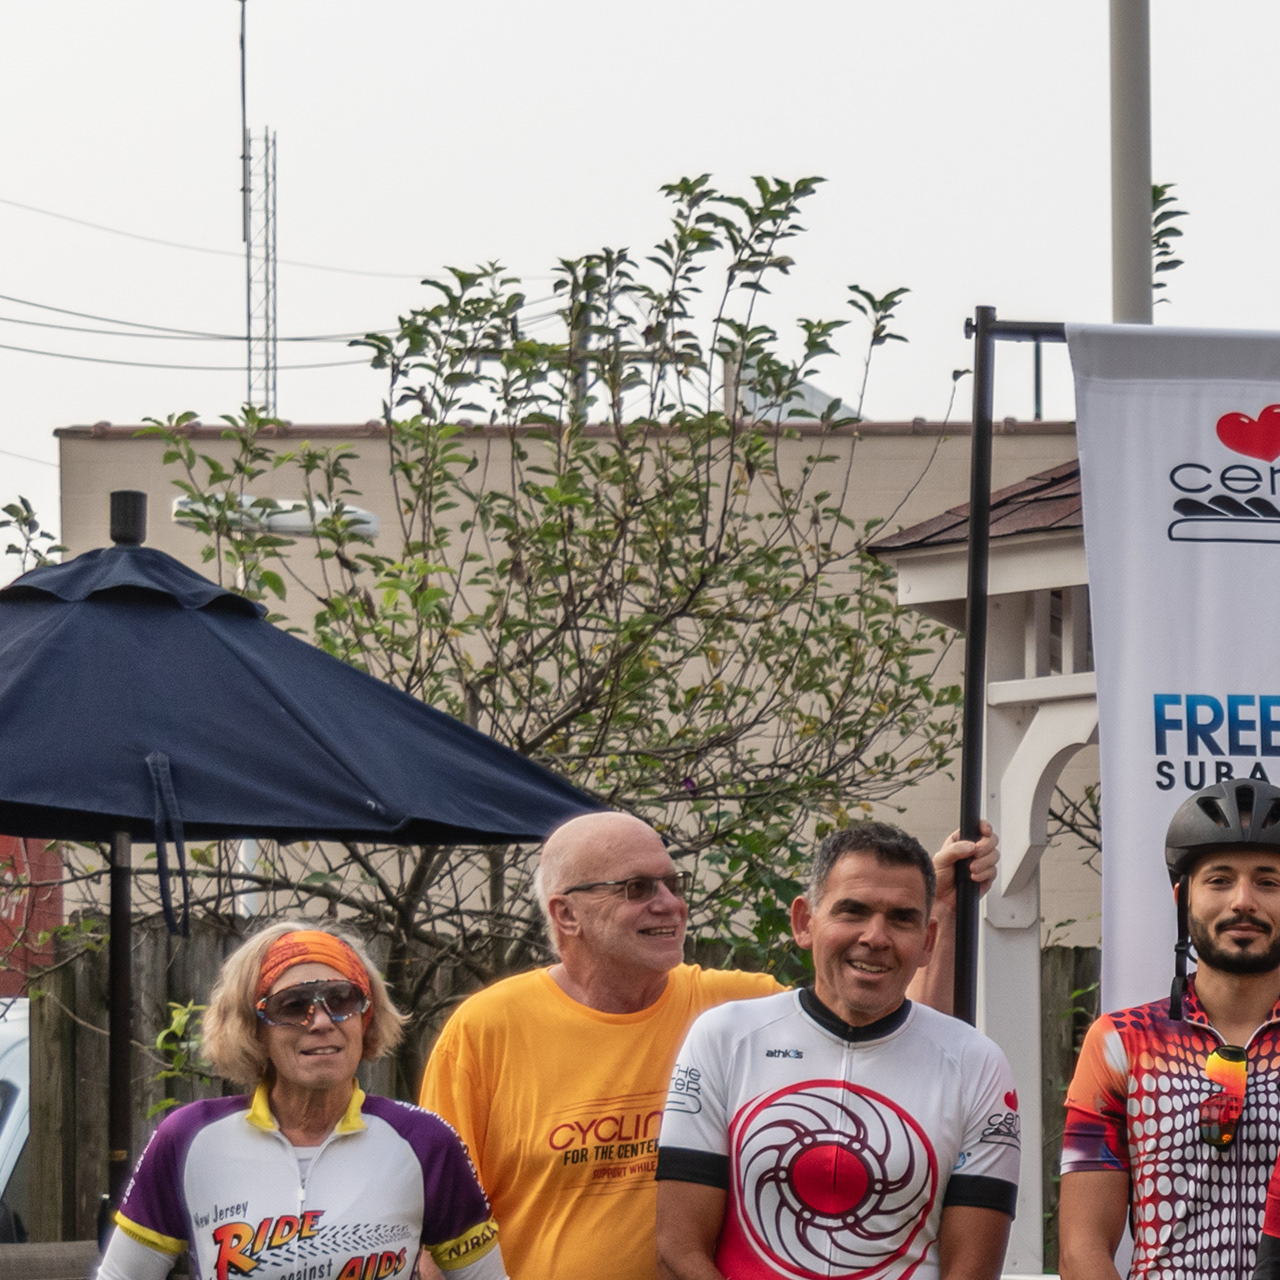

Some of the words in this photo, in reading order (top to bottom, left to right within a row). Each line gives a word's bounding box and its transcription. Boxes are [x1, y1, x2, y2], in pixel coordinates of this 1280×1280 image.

[563, 1147, 588, 1165] FOR
[593, 1145, 613, 1161] THE
[592, 1166, 627, 1180] SUPPORT
[630, 1162, 656, 1175] WHILE
[212, 1201, 249, 1223] Jersey
